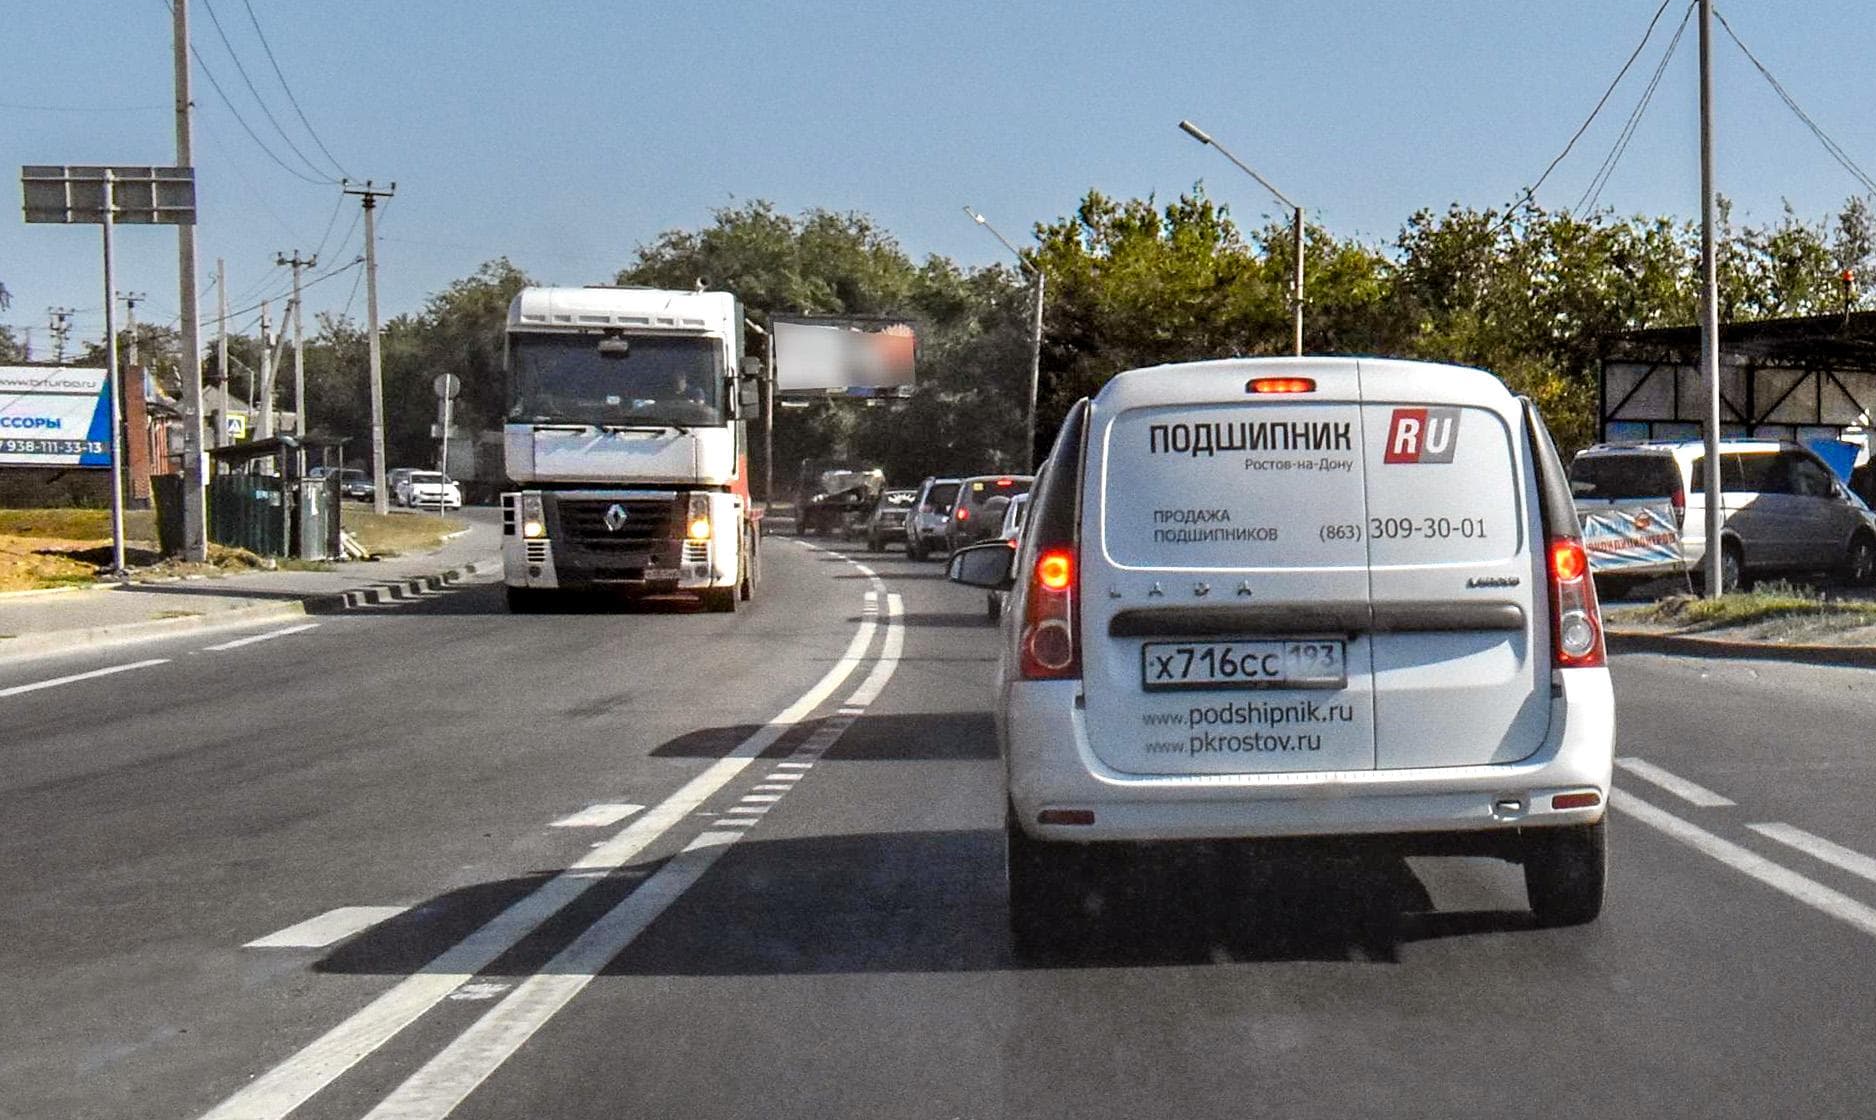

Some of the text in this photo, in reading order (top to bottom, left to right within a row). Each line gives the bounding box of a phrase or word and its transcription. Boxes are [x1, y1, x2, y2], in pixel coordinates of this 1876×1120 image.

[7, 441, 102, 453] 938-111-33-13
[1150, 418, 1453, 457] ПОДШИПНИК RU
[1245, 458, 1353, 472] Ростов-на-Дону
[1153, 510, 1230, 524] ПРОДАЖА
[1153, 527, 1278, 544] ПОДШИПНИКОВ
[1319, 517, 1487, 542] (863) 309-30-01
[1142, 701, 1353, 728] www.podshipnik.ru
[1145, 732, 1321, 757] www.pkrostov.ru
